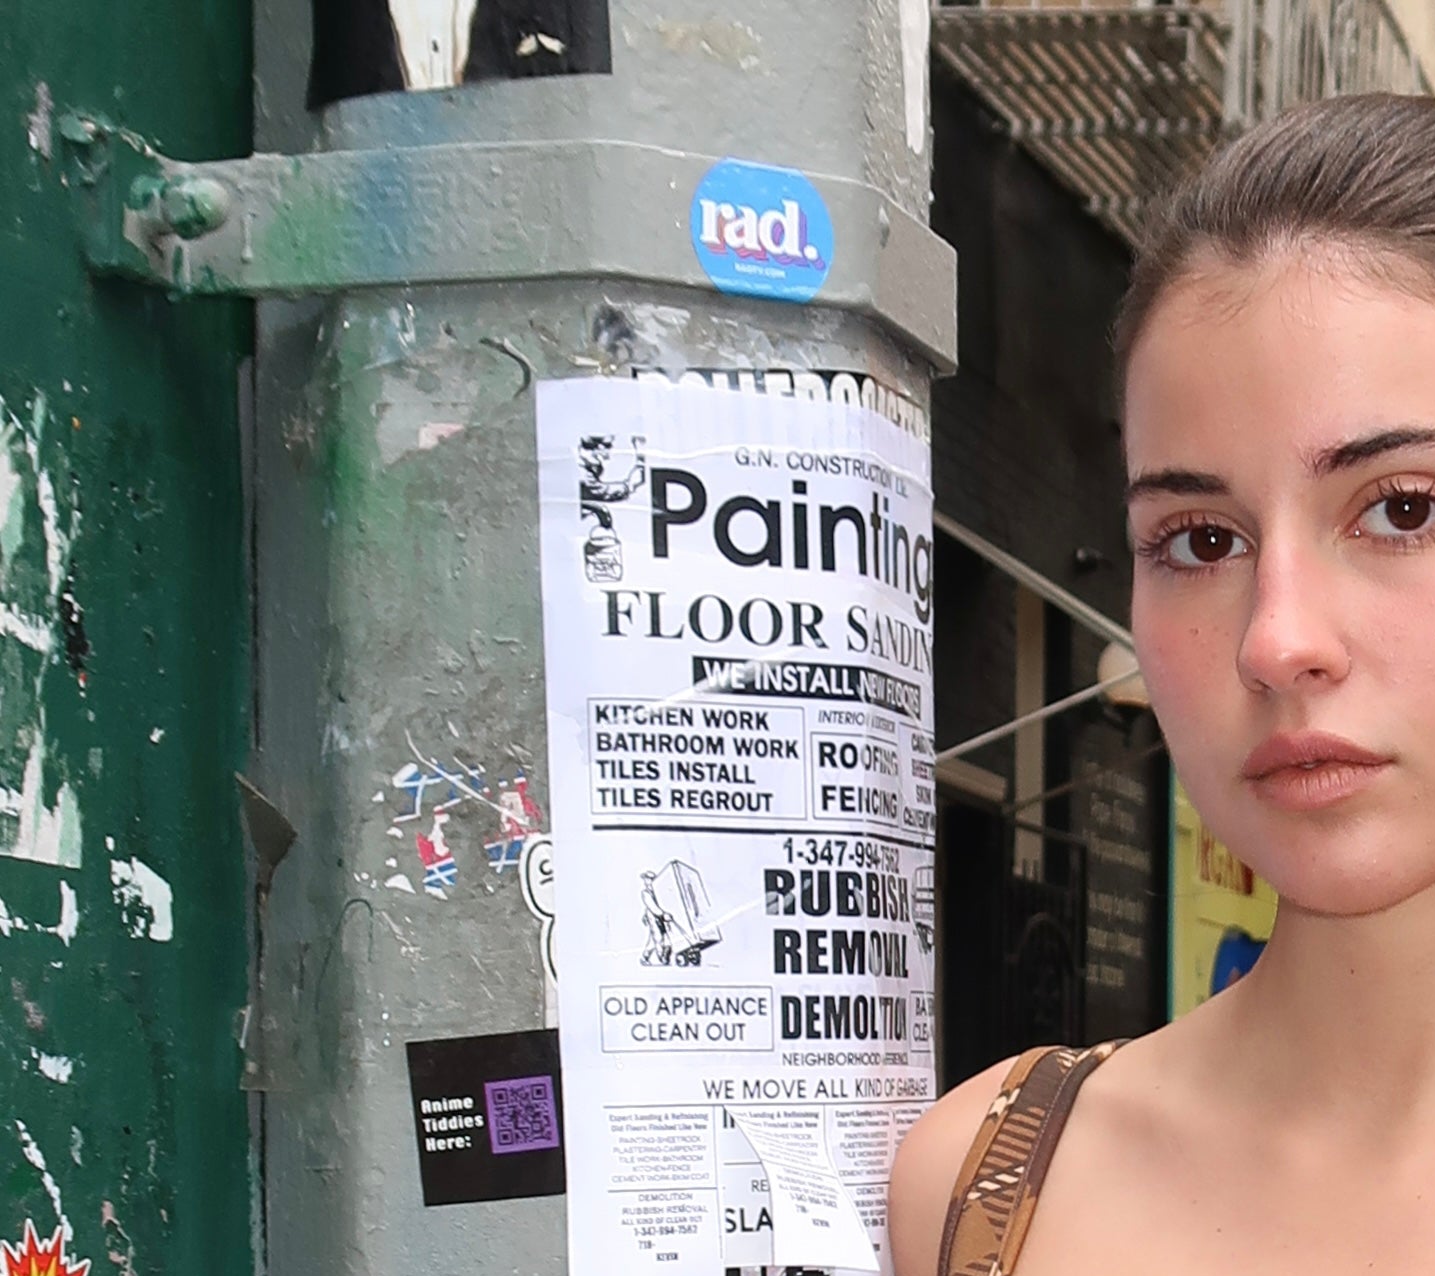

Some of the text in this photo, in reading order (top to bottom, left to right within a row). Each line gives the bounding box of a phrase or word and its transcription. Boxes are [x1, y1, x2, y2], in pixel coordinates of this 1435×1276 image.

[699, 198, 824, 268] rad.
[735, 447, 778, 468] G.N.
[787, 451, 892, 490] CONSTRUCTION
[650, 467, 933, 625] Painting
[601, 589, 829, 649] FLOOR
[702, 659, 746, 690] WE
[754, 663, 855, 696] INSTALL
[595, 704, 769, 730] KITCHEN WORK
[596, 732, 800, 759] BATHROOM WORK
[818, 741, 898, 776] ROOFING
[596, 759, 756, 784] TILES INSTALL
[596, 787, 773, 812] TILES REGROUT
[822, 785, 898, 819] FENCING
[764, 869, 910, 923] RUBBISH
[774, 929, 909, 979] REMOVAL
[604, 997, 767, 1016] OLD APPLIANCE
[631, 1023, 746, 1041] CLEAN OUT
[782, 1051, 881, 1066] NEIGHBORHOOD
[703, 1079, 734, 1100] WE
[743, 1079, 806, 1100] MOVE
[814, 1079, 849, 1099] ALL
[855, 1077, 882, 1098] KIND
[884, 1077, 896, 1097] OF
[421, 1096, 474, 1114] Anime
[422, 1114, 484, 1133] Tiddies
[425, 1136, 472, 1152] Here:
[638, 1193, 694, 1202] DEMOLITION
